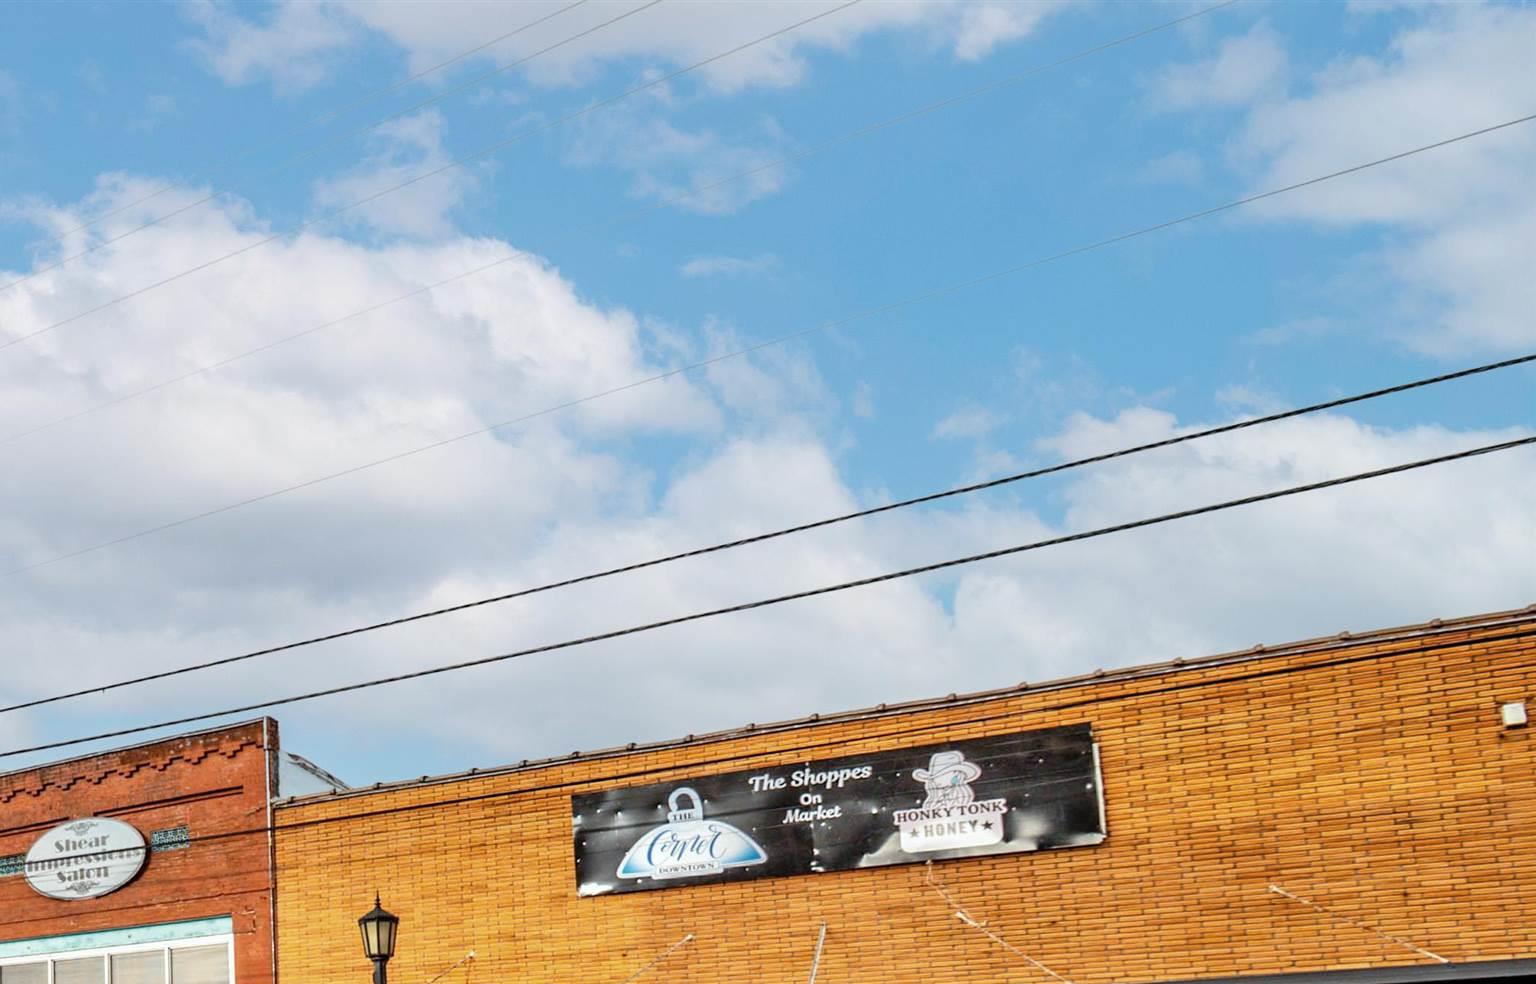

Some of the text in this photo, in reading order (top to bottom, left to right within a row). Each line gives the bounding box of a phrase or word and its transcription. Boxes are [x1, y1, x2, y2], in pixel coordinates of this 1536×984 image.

[748, 766, 873, 792] The Shoppes
[800, 793, 822, 805] On
[672, 812, 695, 821] THE
[782, 805, 842, 824] Market
[896, 801, 1003, 823] HONKY TONK
[924, 820, 978, 837] HONEY
[54, 834, 110, 853] Shear
[56, 866, 109, 882] Salon
[658, 863, 715, 874] DOWNTOWN
